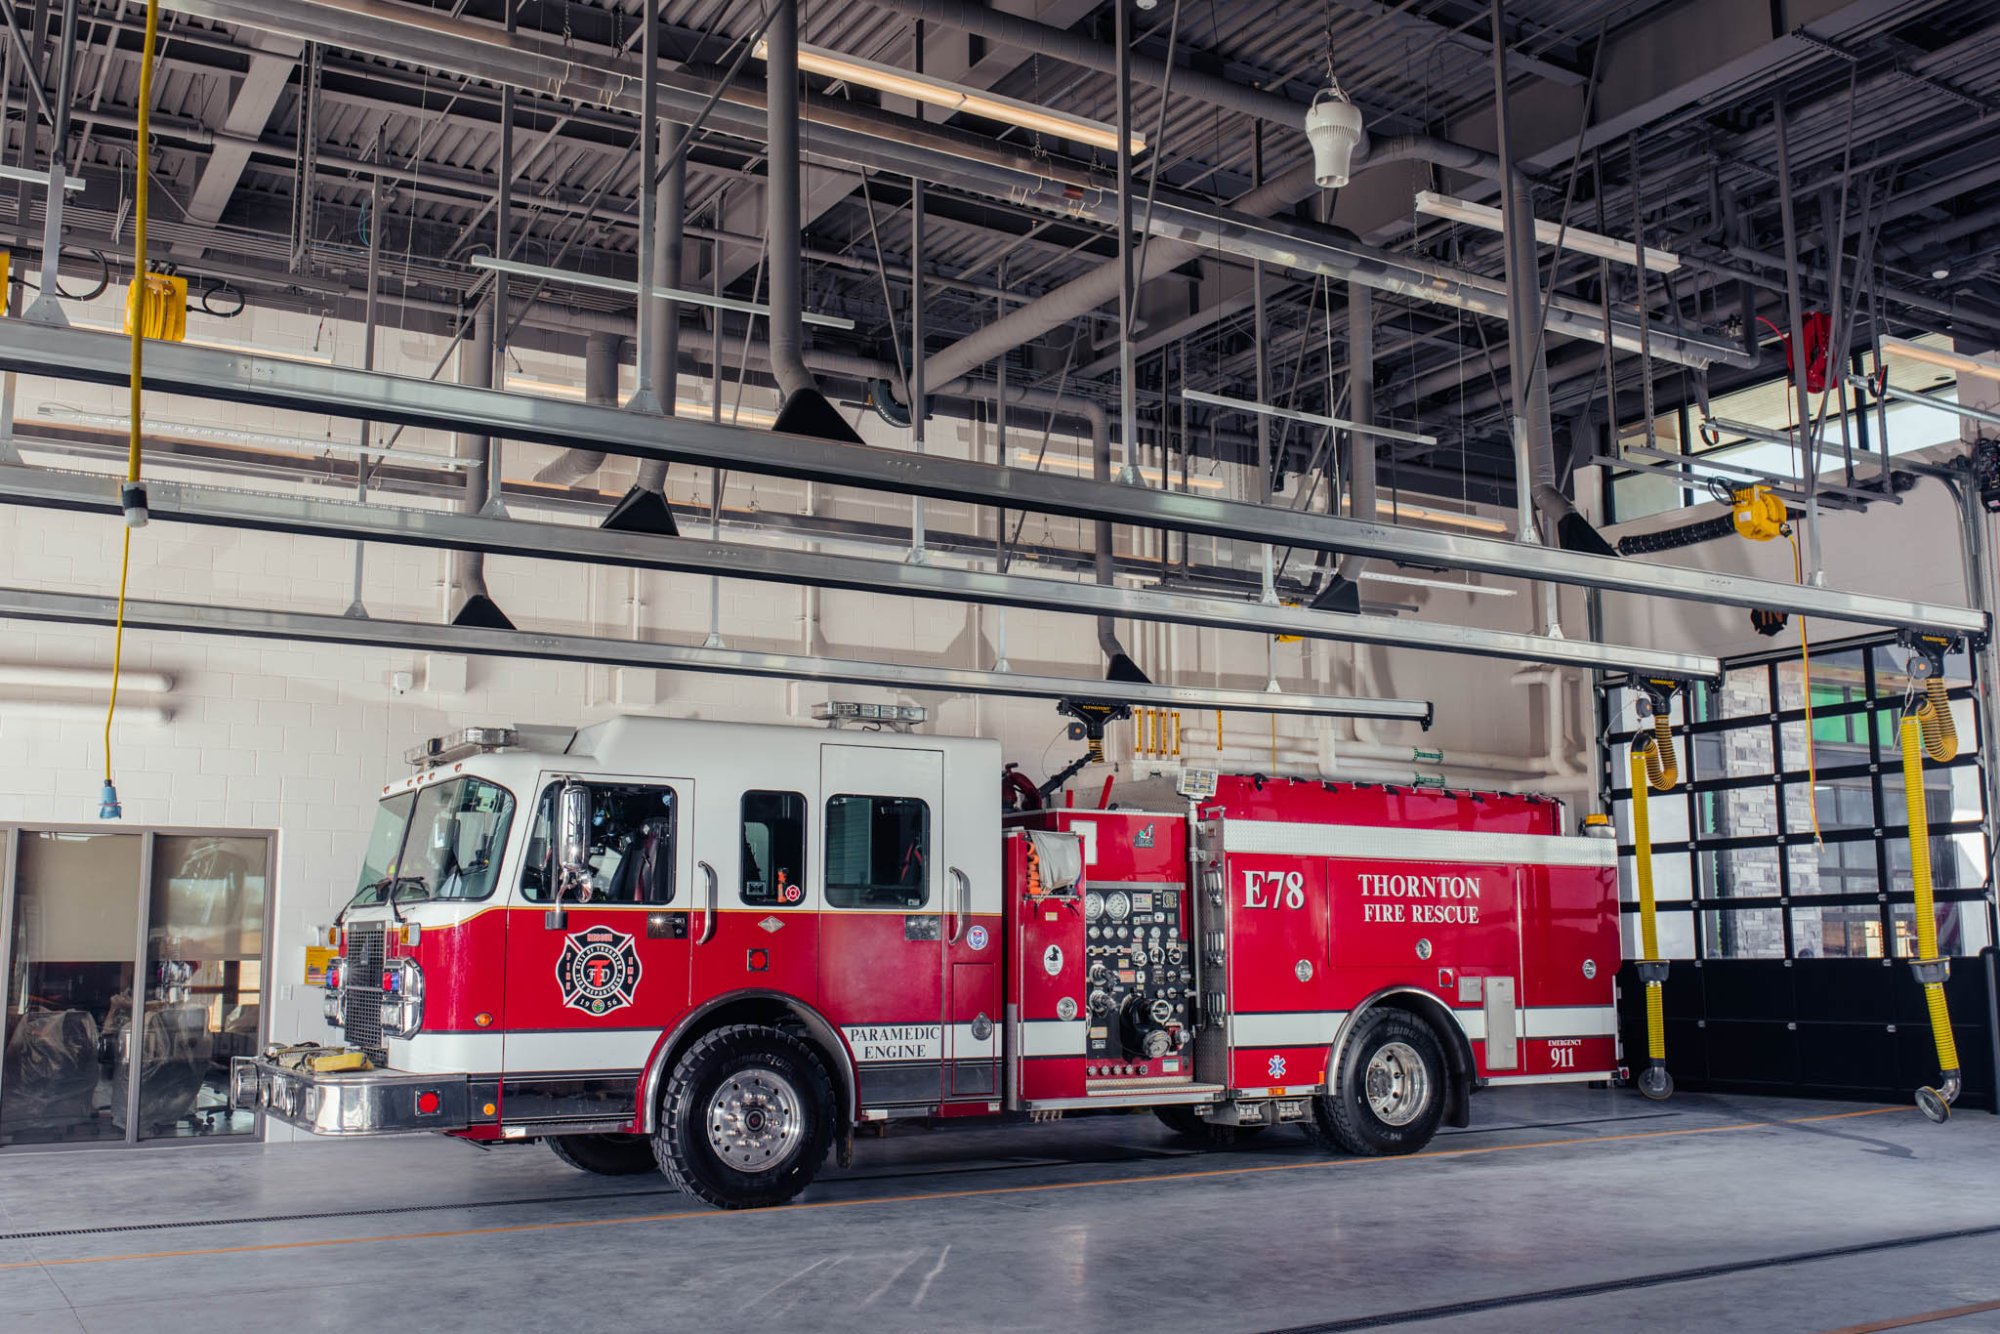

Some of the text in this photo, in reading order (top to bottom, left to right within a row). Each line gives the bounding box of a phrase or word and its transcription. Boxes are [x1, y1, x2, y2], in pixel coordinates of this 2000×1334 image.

[1242, 870, 1305, 909] E78
[1358, 873, 1481, 899] THORNTON
[1364, 904, 1480, 924] FIRE RESCUE
[576, 955, 586, 970] CITY
[596, 946, 623, 970] THORNTON
[586, 974, 622, 996] DEPARTMENT
[580, 998, 617, 1007] 19 56
[850, 1026, 940, 1042] PARAMEDIC
[1548, 1039, 1582, 1047] EMERGENCY
[864, 1044, 927, 1059] ENGINE
[1551, 1047, 1575, 1068] 911
